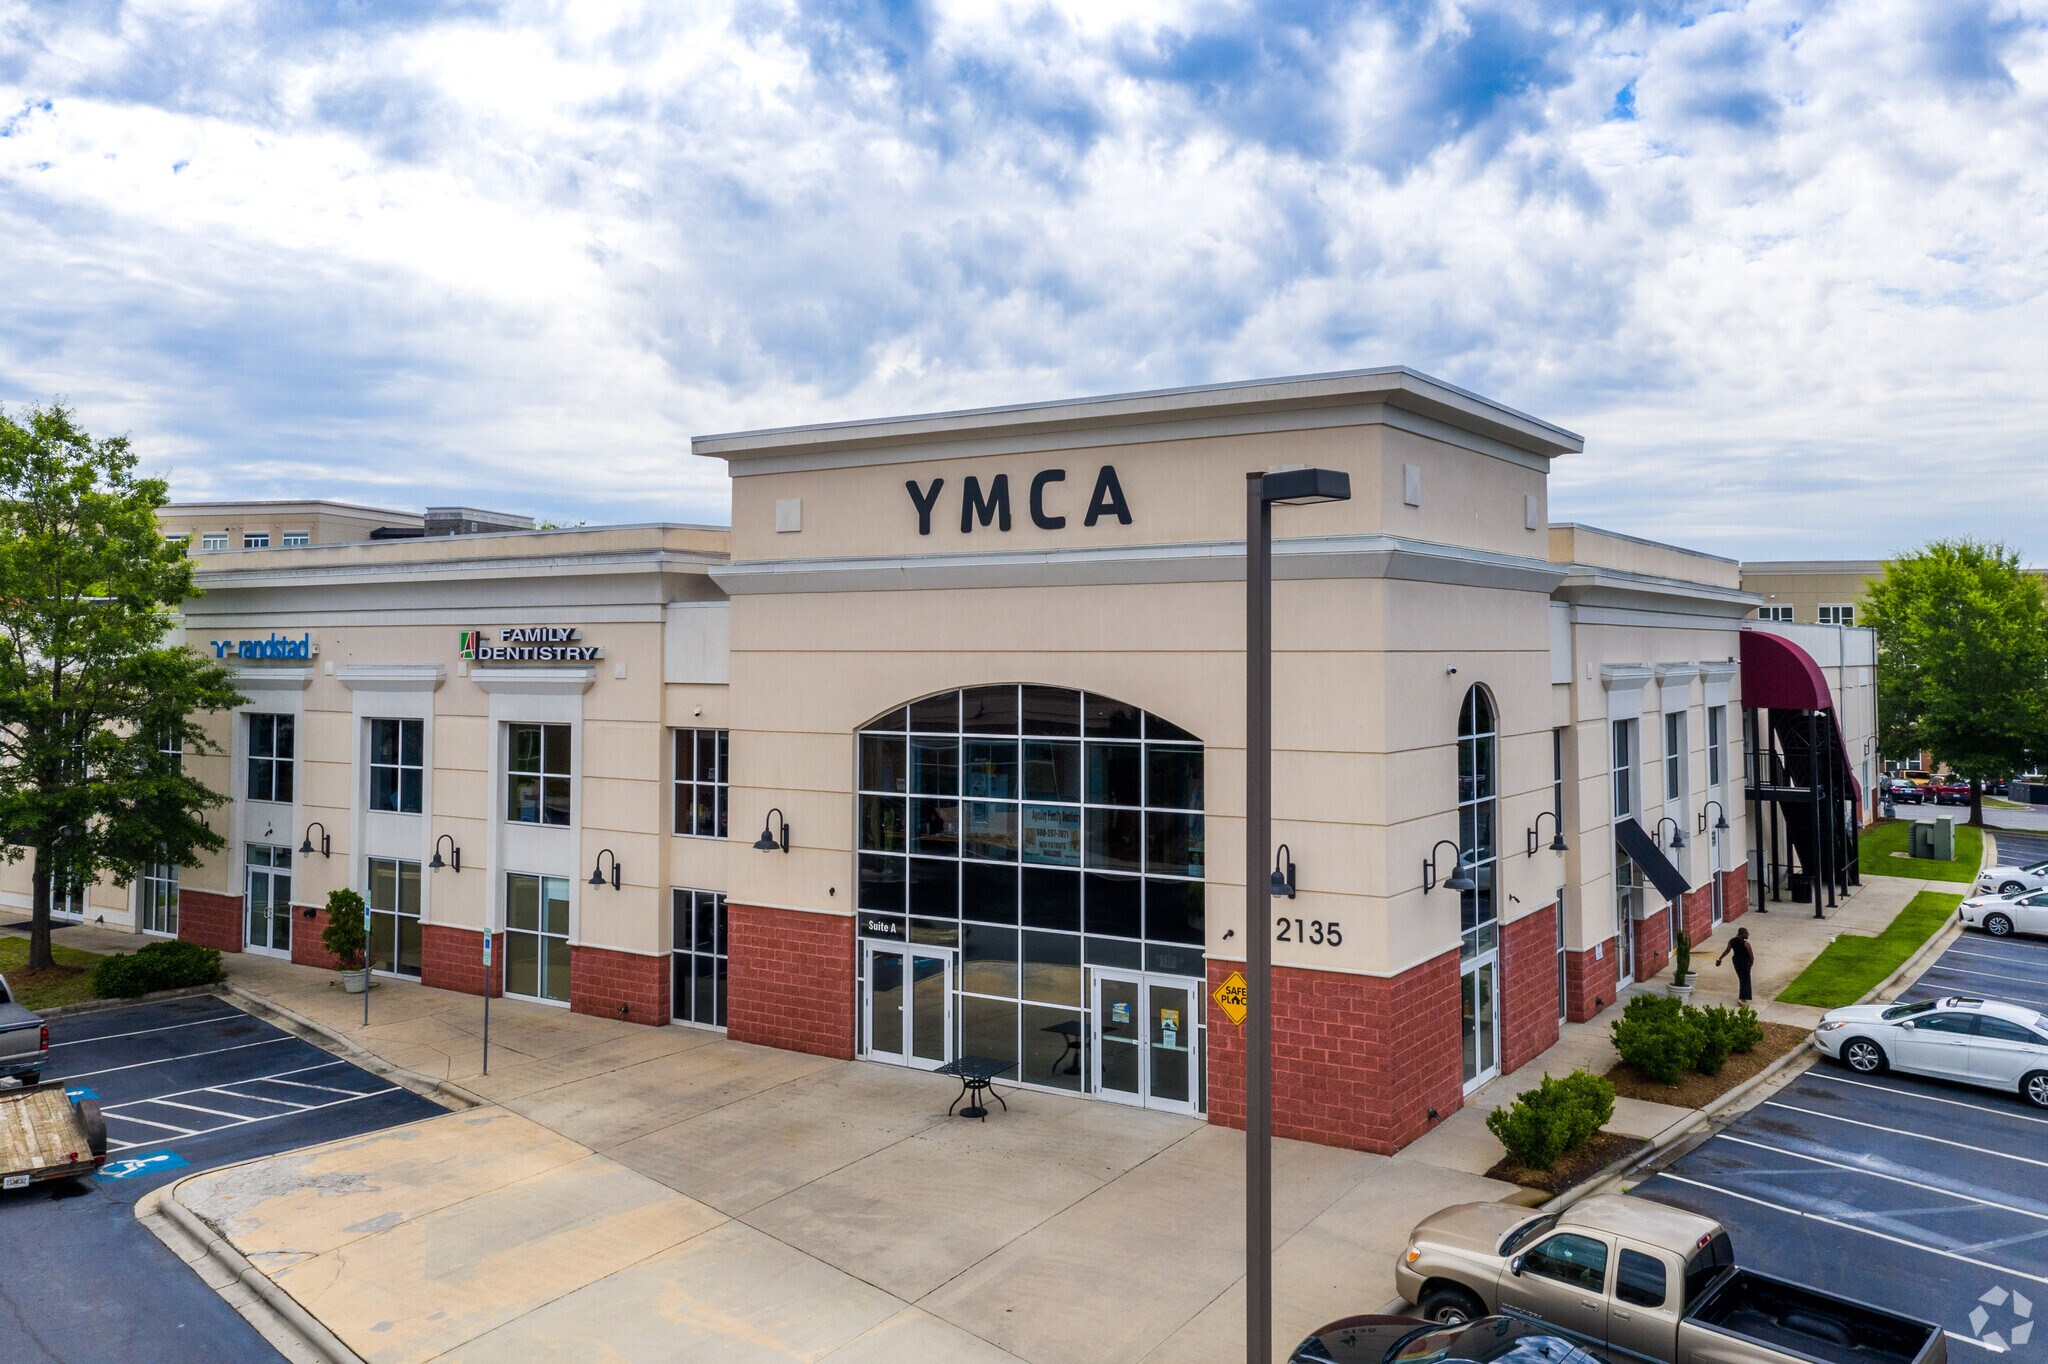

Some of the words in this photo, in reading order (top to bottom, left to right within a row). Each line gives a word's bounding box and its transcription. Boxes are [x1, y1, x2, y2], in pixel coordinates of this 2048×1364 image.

[905, 465, 1133, 535] YMCA
[500, 628, 573, 642] FAMILY
[238, 632, 310, 659] randstad
[479, 647, 595, 661] DENTISTRY
[868, 920, 889, 932] Suite
[890, 923, 897, 934] A
[1276, 917, 1342, 947] 2135
[1226, 986, 1246, 996] SAFE
